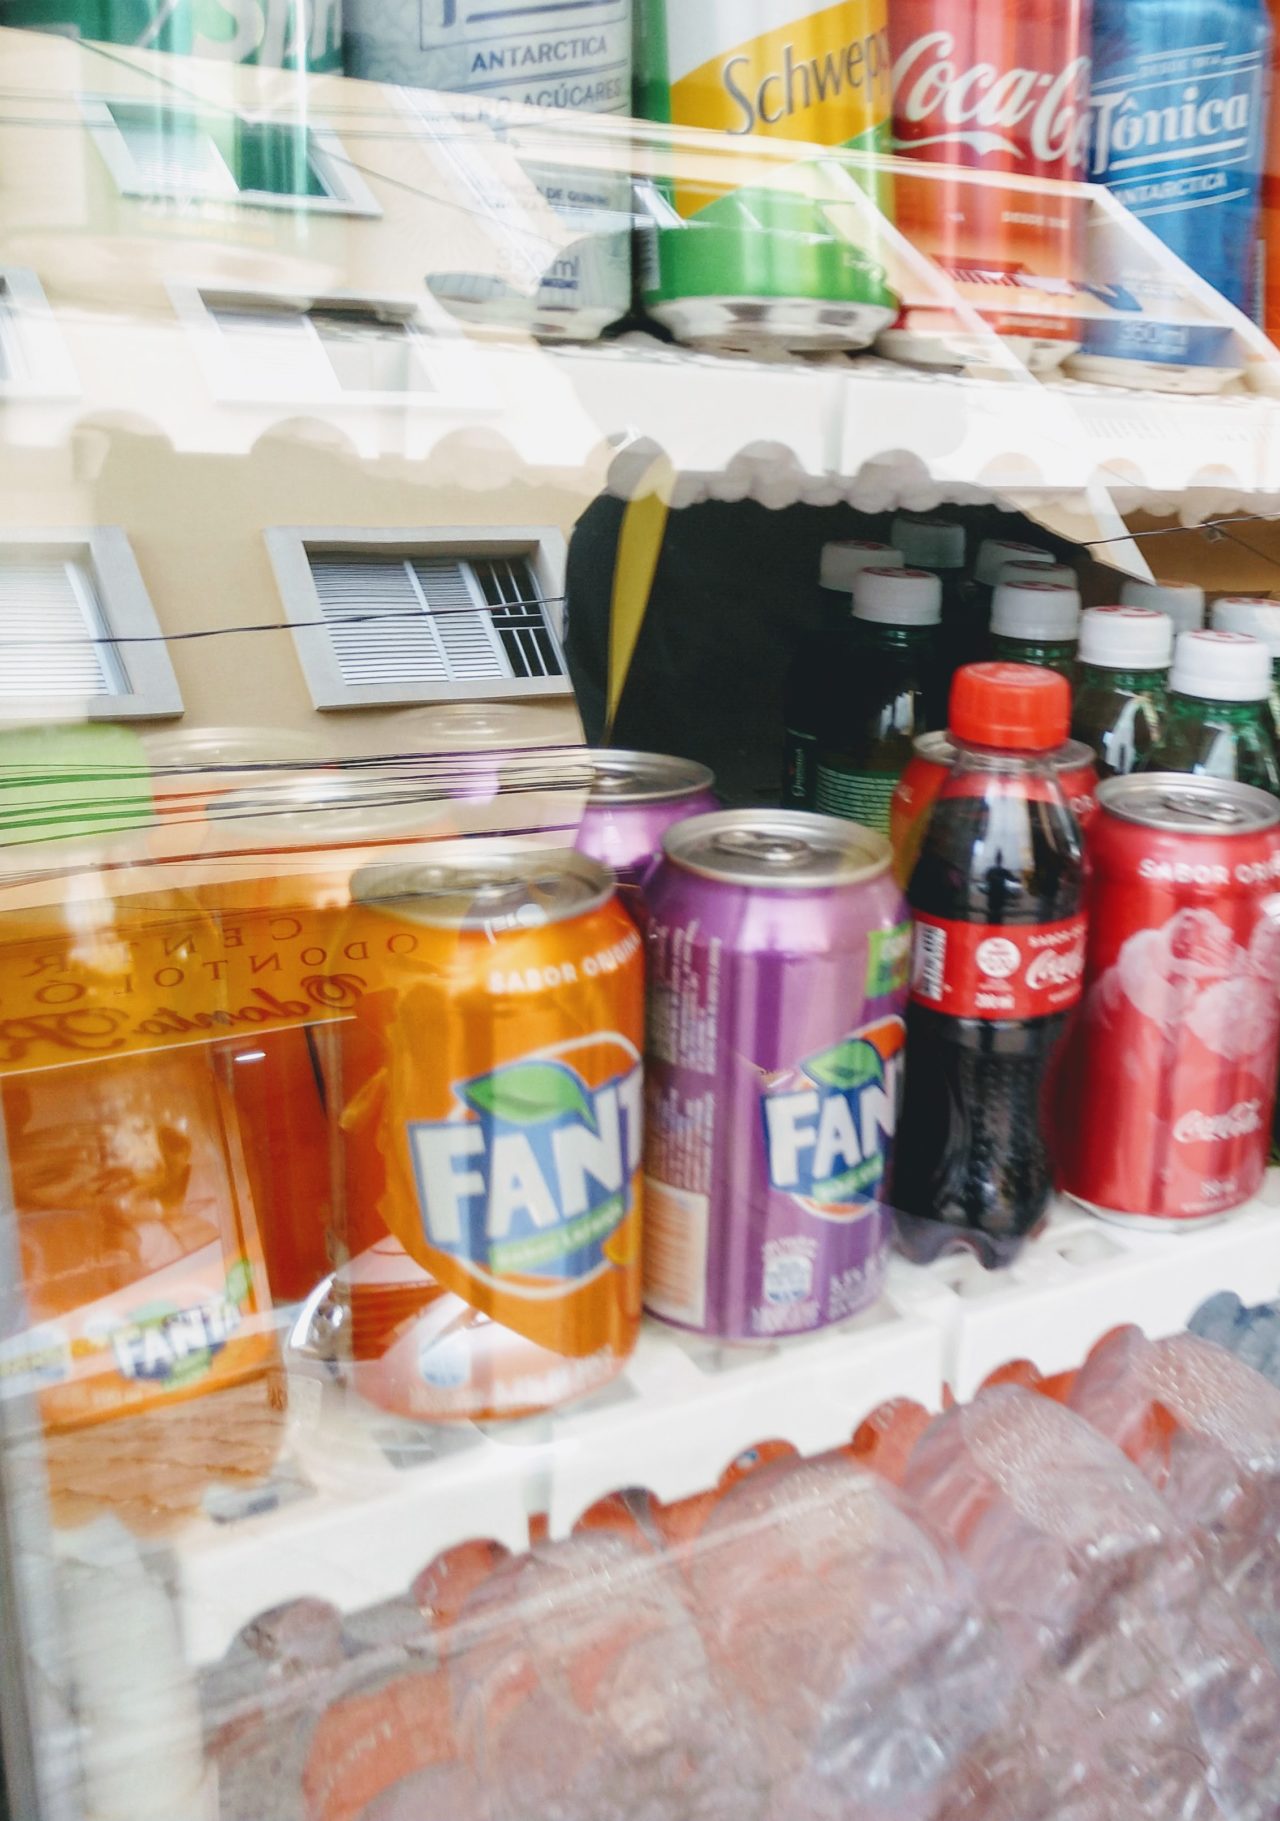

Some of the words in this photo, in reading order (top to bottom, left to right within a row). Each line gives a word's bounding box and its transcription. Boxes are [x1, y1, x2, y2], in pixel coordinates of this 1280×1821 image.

[470, 36, 608, 73] ANTARCTICA
[1090, 85, 1251, 175] Tônica
[488, 962, 578, 994] SABOR
